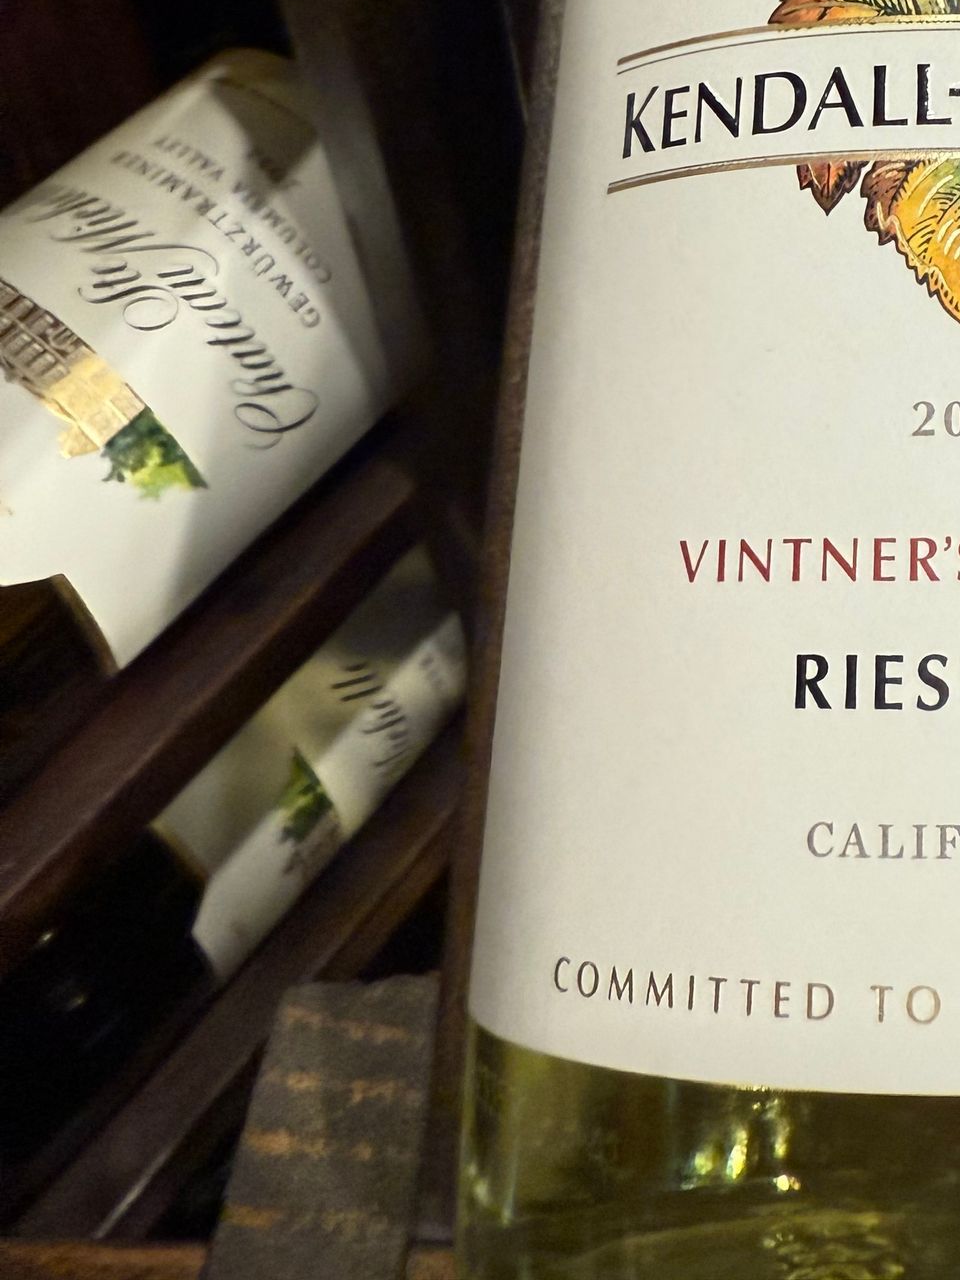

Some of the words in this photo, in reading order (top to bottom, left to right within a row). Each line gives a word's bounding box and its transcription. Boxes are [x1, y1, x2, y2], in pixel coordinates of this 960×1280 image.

[156, 263, 320, 450] Chateau
[553, 956, 836, 1021] COMMITTED
[870, 984, 942, 1025] TO
